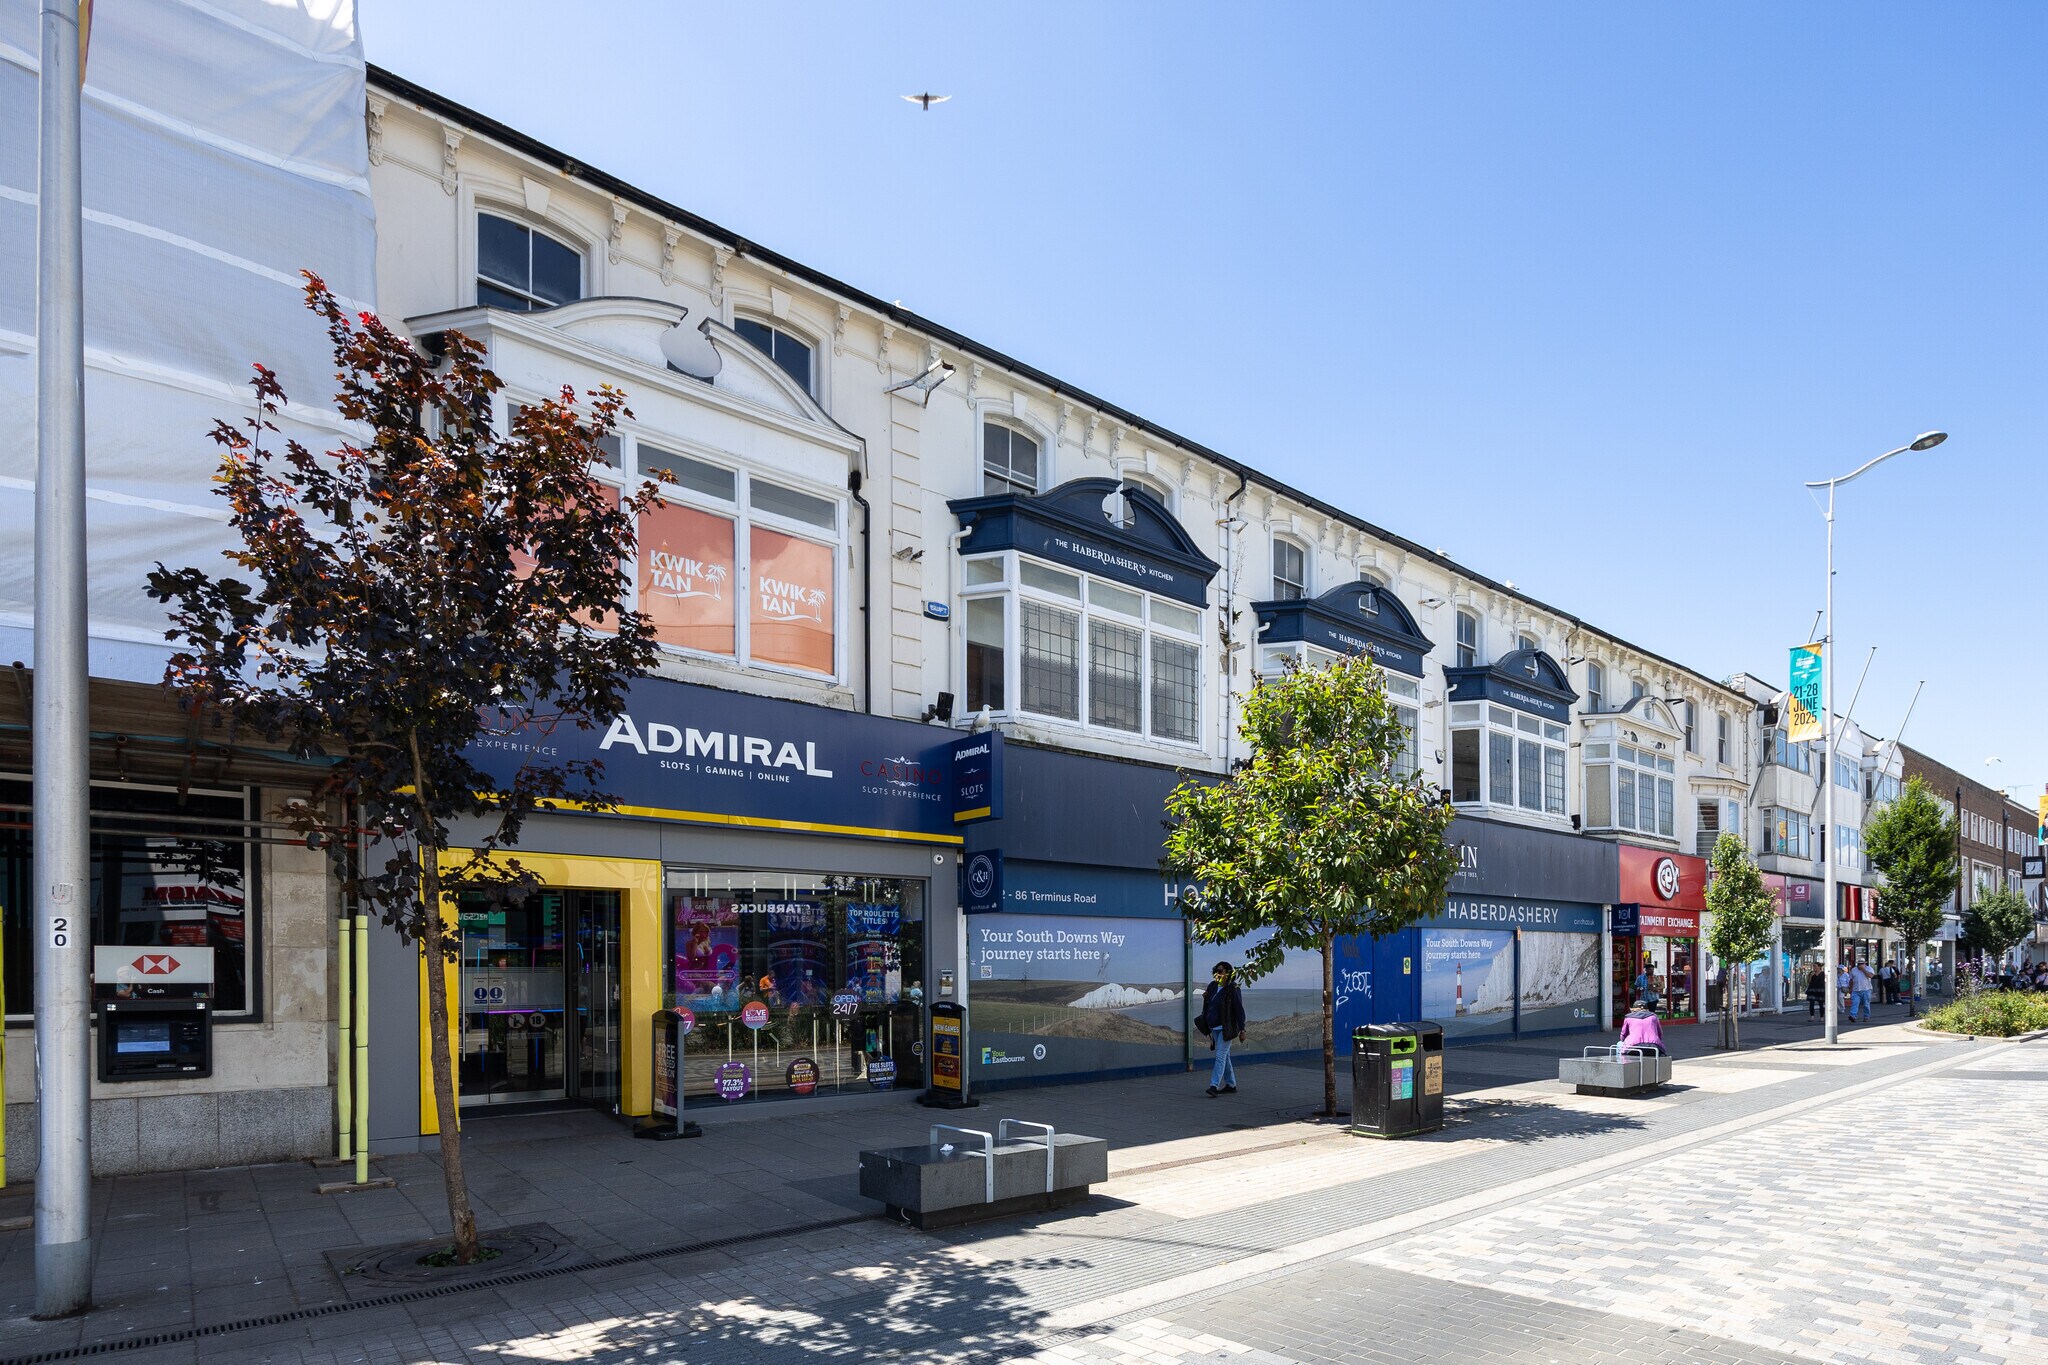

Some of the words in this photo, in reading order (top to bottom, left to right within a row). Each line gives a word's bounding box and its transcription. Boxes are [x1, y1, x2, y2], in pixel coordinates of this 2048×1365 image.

[650, 549, 704, 578] KWIK
[1055, 538, 1068, 549] THE
[1072, 543, 1146, 576] HABERDASHER'S
[1149, 568, 1174, 582] KITCHEN
[652, 569, 691, 593] TAN
[760, 576, 806, 603] KWIK
[761, 595, 796, 616] TAN
[1339, 633, 1385, 657] HABERDASER'S
[1793, 683, 1818, 699] 21-28
[1793, 697, 1818, 713] JUNE
[478, 706, 557, 735] SINO
[1794, 711, 1818, 726] 2025
[476, 738, 558, 756] EXPERIENCE
[598, 713, 833, 779] ADMIRAL
[954, 743, 990, 762] ADMIRAL
[660, 760, 691, 771] SLOTS
[705, 765, 744, 777] GAMING
[757, 772, 791, 783] ONLINE
[860, 760, 942, 785] CASINO
[862, 785, 889, 796] SLOTS
[891, 789, 942, 802] EXPERIENCE
[961, 783, 984, 797] SLOTS
[1015, 890, 1028, 901] 86
[1030, 891, 1072, 903] Terminus
[1074, 893, 1097, 904] Road
[784, 915, 811, 923] TITLES
[849, 909, 863, 917] TOP
[864, 910, 899, 919] ROULETTE
[862, 917, 886, 925] TITLES
[1448, 901, 1559, 924] HABERDASHERY
[1667, 917, 1694, 928] EXCHANGE
[980, 929, 1014, 943] Your
[1016, 929, 1054, 943] South
[1057, 930, 1098, 944] Downs
[1101, 931, 1125, 948] Way
[1426, 938, 1441, 948] Your
[1441, 937, 1459, 948] South
[1460, 938, 1480, 949] Downs
[1480, 939, 1493, 950] Way
[980, 947, 1034, 964] journey
[1036, 947, 1071, 961] starts
[1074, 947, 1100, 961] here
[1425, 951, 1450, 962] journey
[1451, 950, 1466, 960] starts
[1466, 950, 1481, 959] here
[834, 994, 858, 1003] OPEN
[832, 1003, 859, 1016] 24/7
[934, 1023, 944, 1031] NEW
[944, 1024, 960, 1034] GAMES
[655, 1043, 676, 1060] FREE
[992, 1056, 1026, 1064] Eastbourne
[722, 1078, 744, 1087] 97.3%
